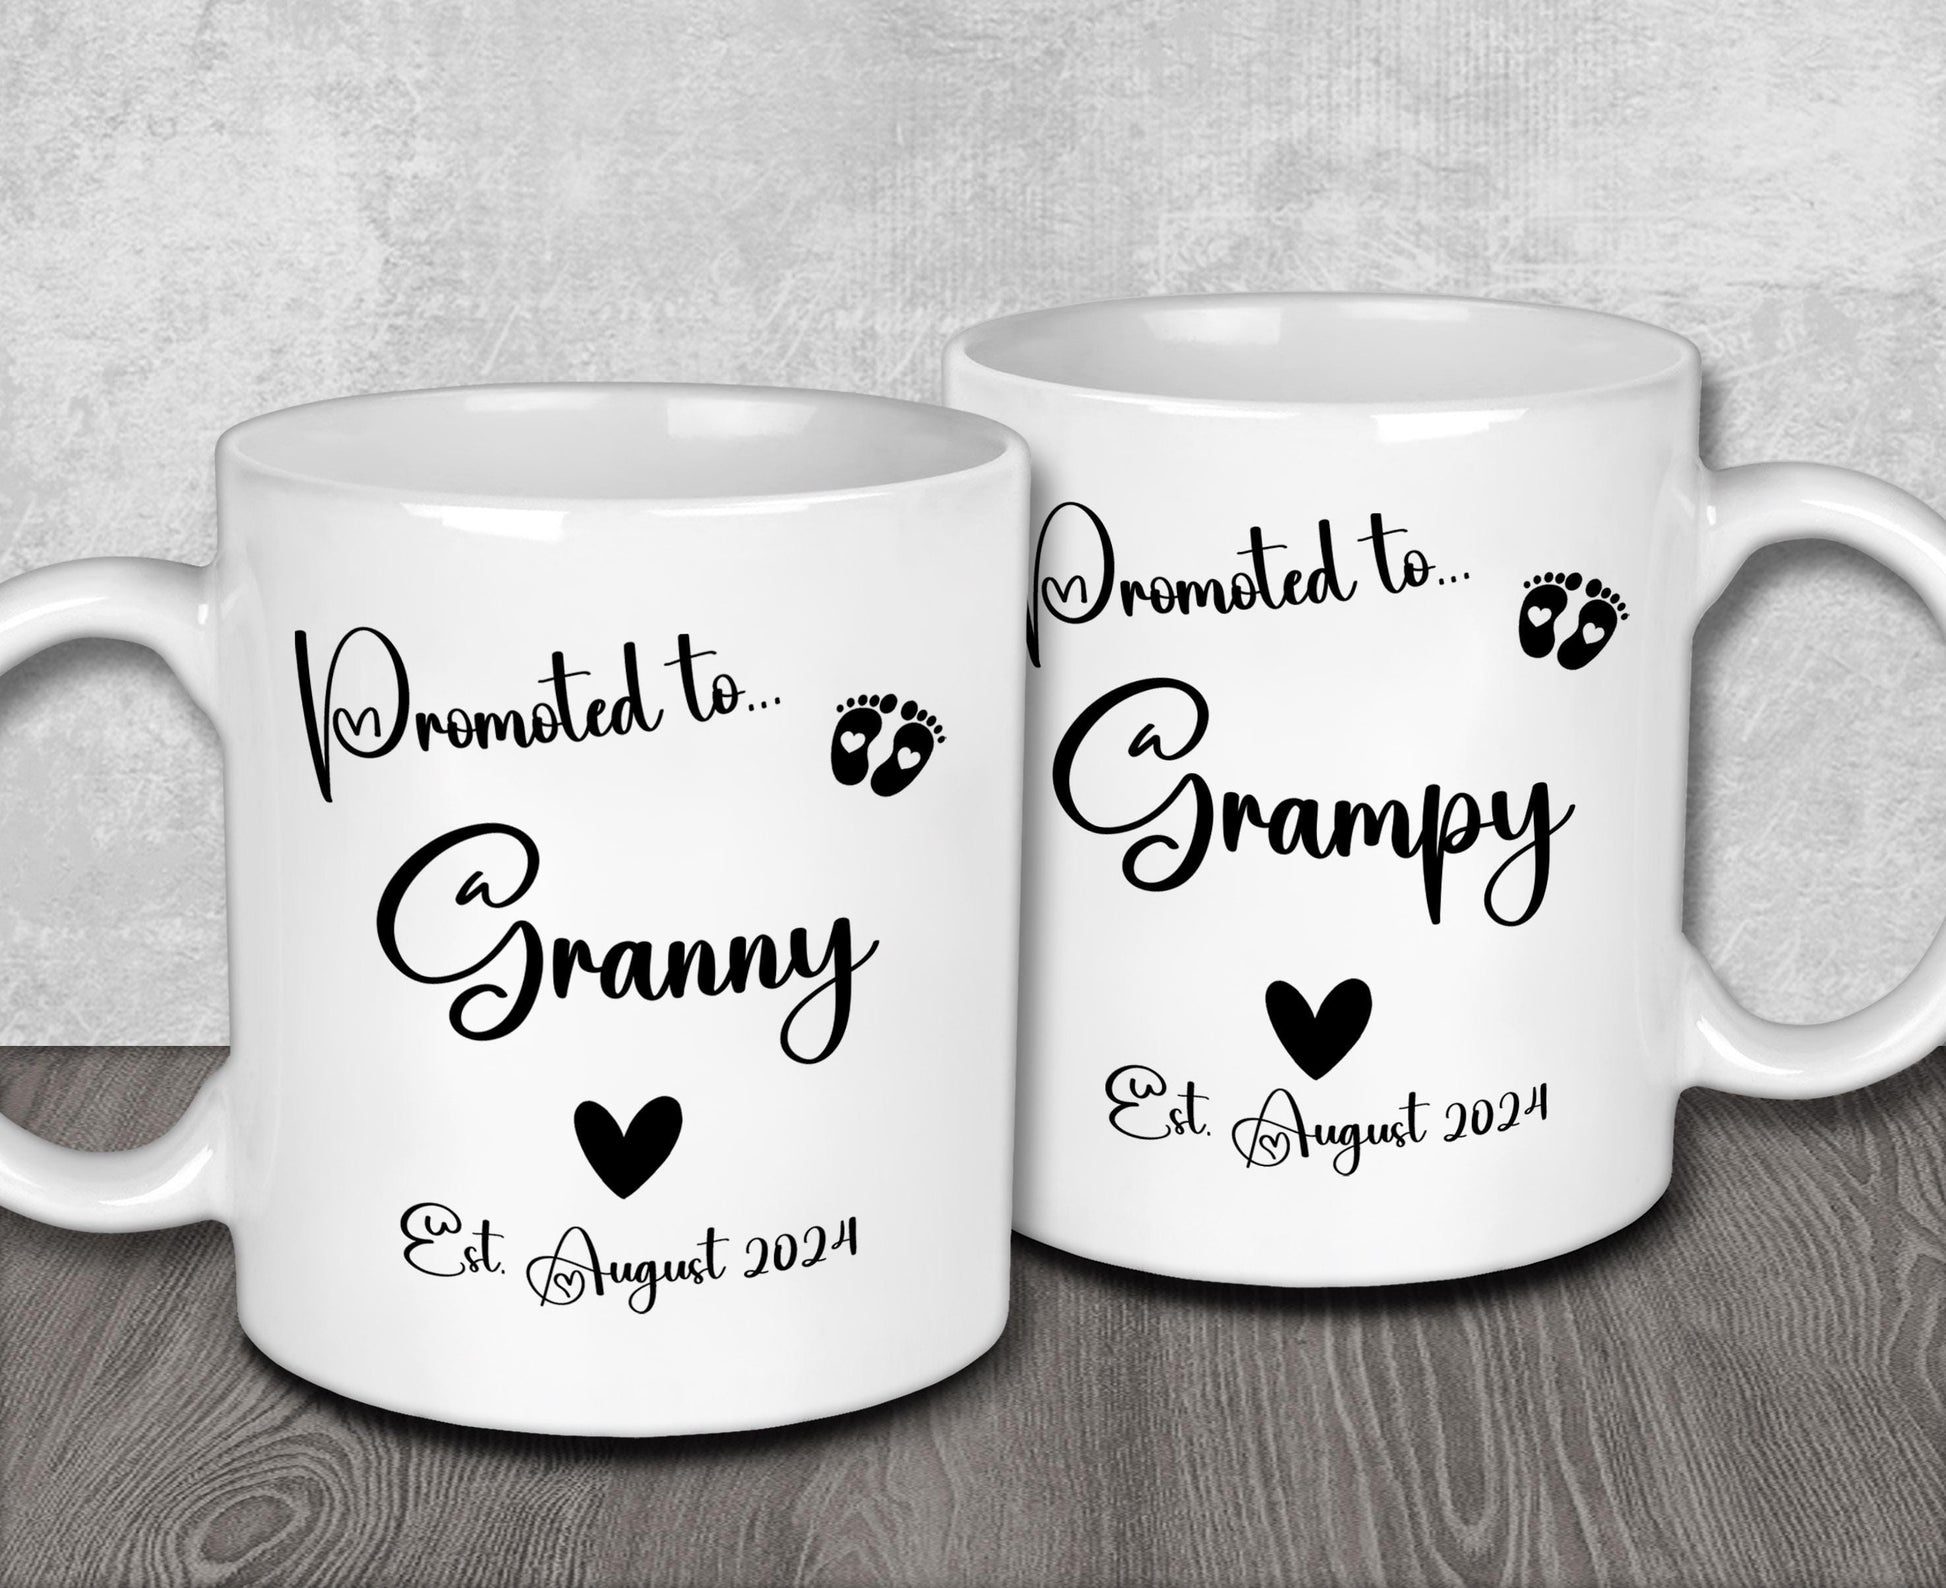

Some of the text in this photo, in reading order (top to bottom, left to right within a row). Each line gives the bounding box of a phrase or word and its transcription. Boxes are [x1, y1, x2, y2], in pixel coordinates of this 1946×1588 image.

[1026, 501, 1357, 669] Promoted
[294, 626, 664, 803] Promoted
[1052, 677, 1576, 927] Grampy
[376, 822, 880, 1065] Granny
[1104, 1064, 1548, 1177] Est. August 2024
[400, 1202, 857, 1315] Est. August 2024
